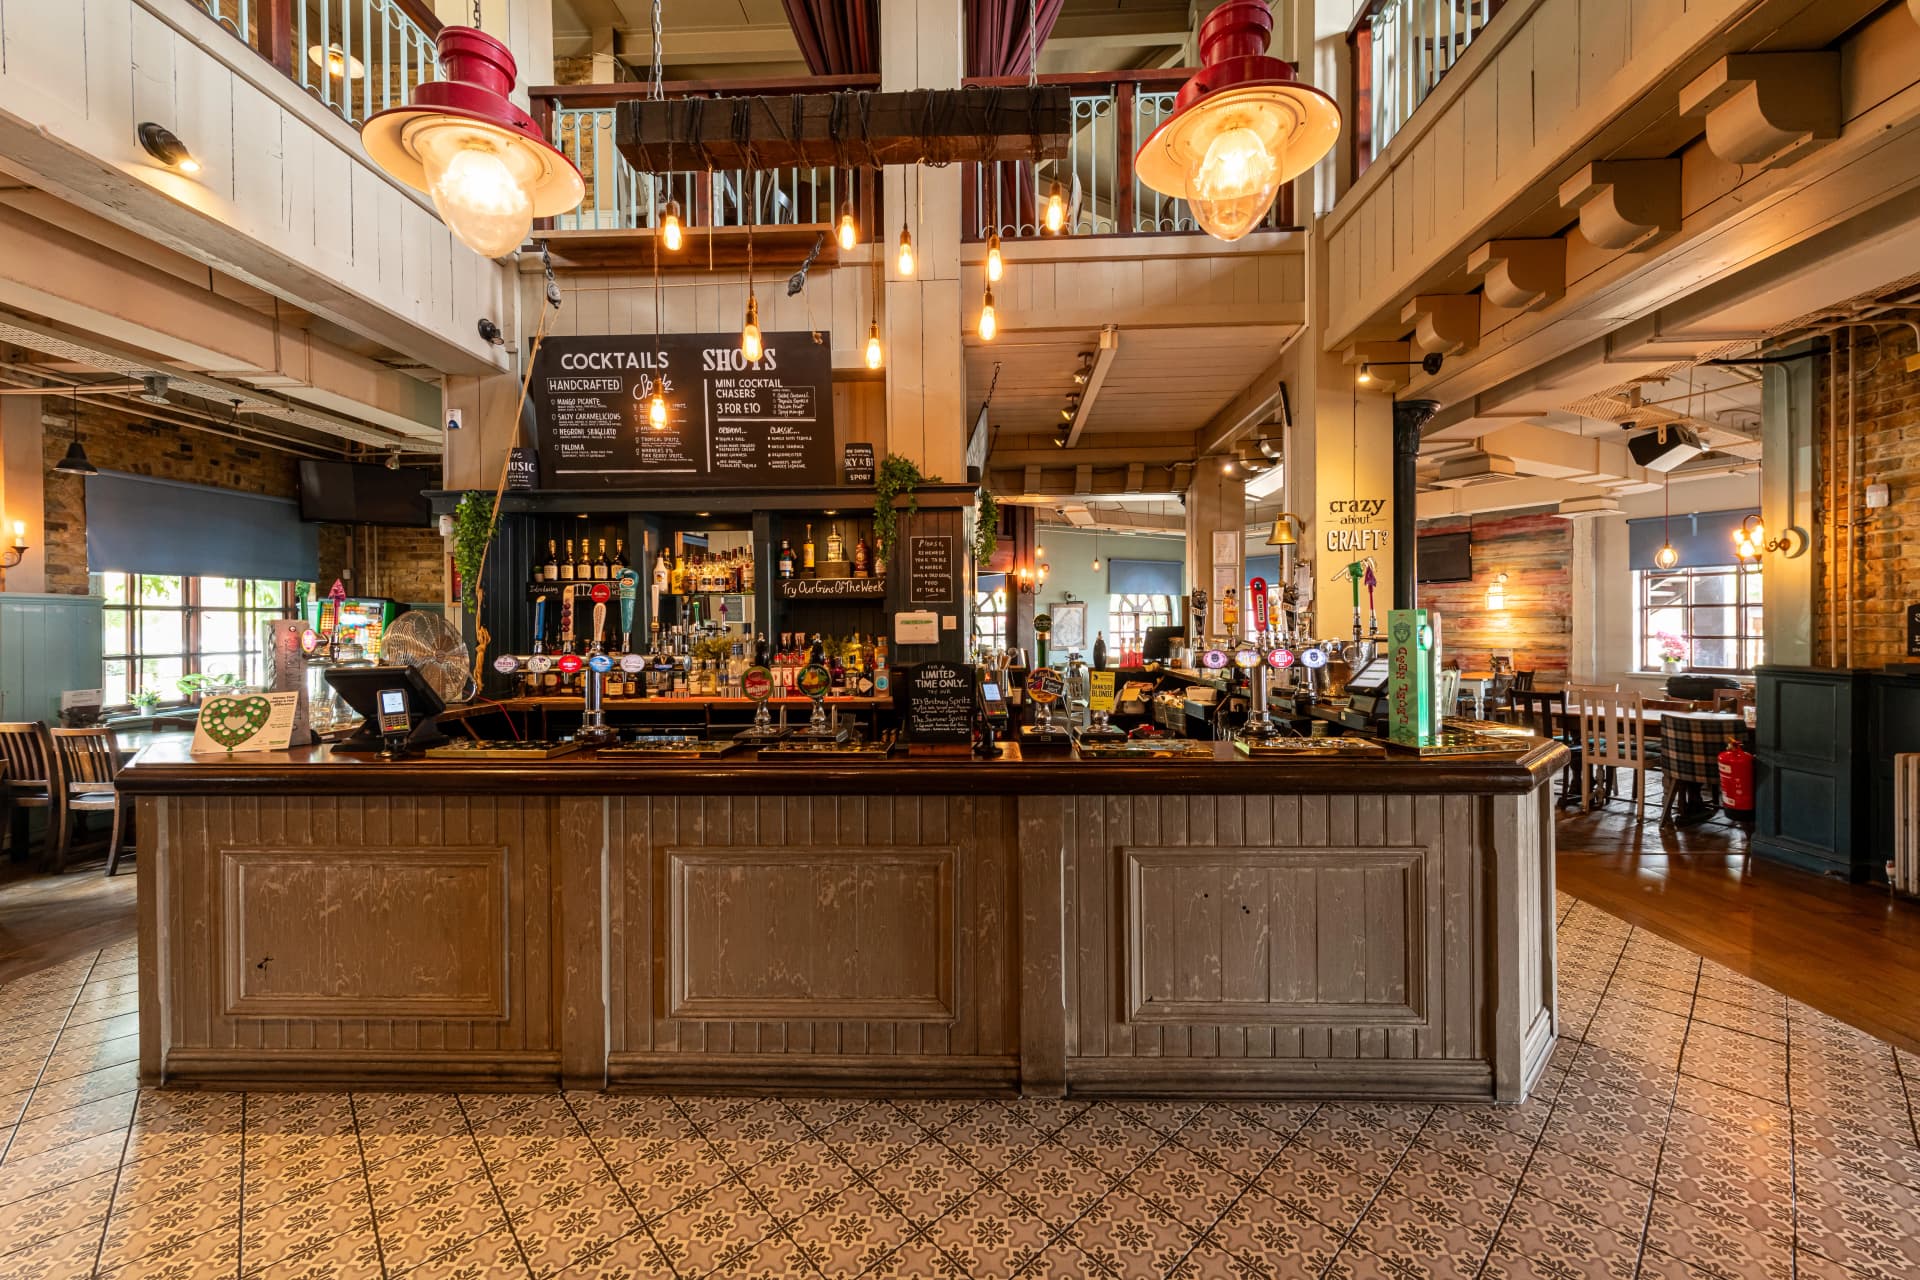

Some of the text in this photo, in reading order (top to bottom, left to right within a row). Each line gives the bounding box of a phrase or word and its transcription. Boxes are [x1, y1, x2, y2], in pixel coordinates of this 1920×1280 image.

[561, 351, 669, 370] COCKTAILS
[549, 379, 620, 392] HANDCRAFTED
[632, 373, 674, 400] Sptz
[715, 379, 783, 388] MINI COCKTAIL
[716, 389, 756, 399] CHASERS
[557, 398, 600, 406] MANGO PICANTE
[717, 402, 761, 414] 3 FOR £10
[1329, 499, 1387, 517] crazy
[1340, 514, 1372, 525] about
[1326, 529, 1389, 552] CRAFT?
[782, 581, 797, 598] Try
[798, 580, 815, 594] Our
[921, 670, 956, 680] LIMITED
[914, 679, 938, 689] TIME
